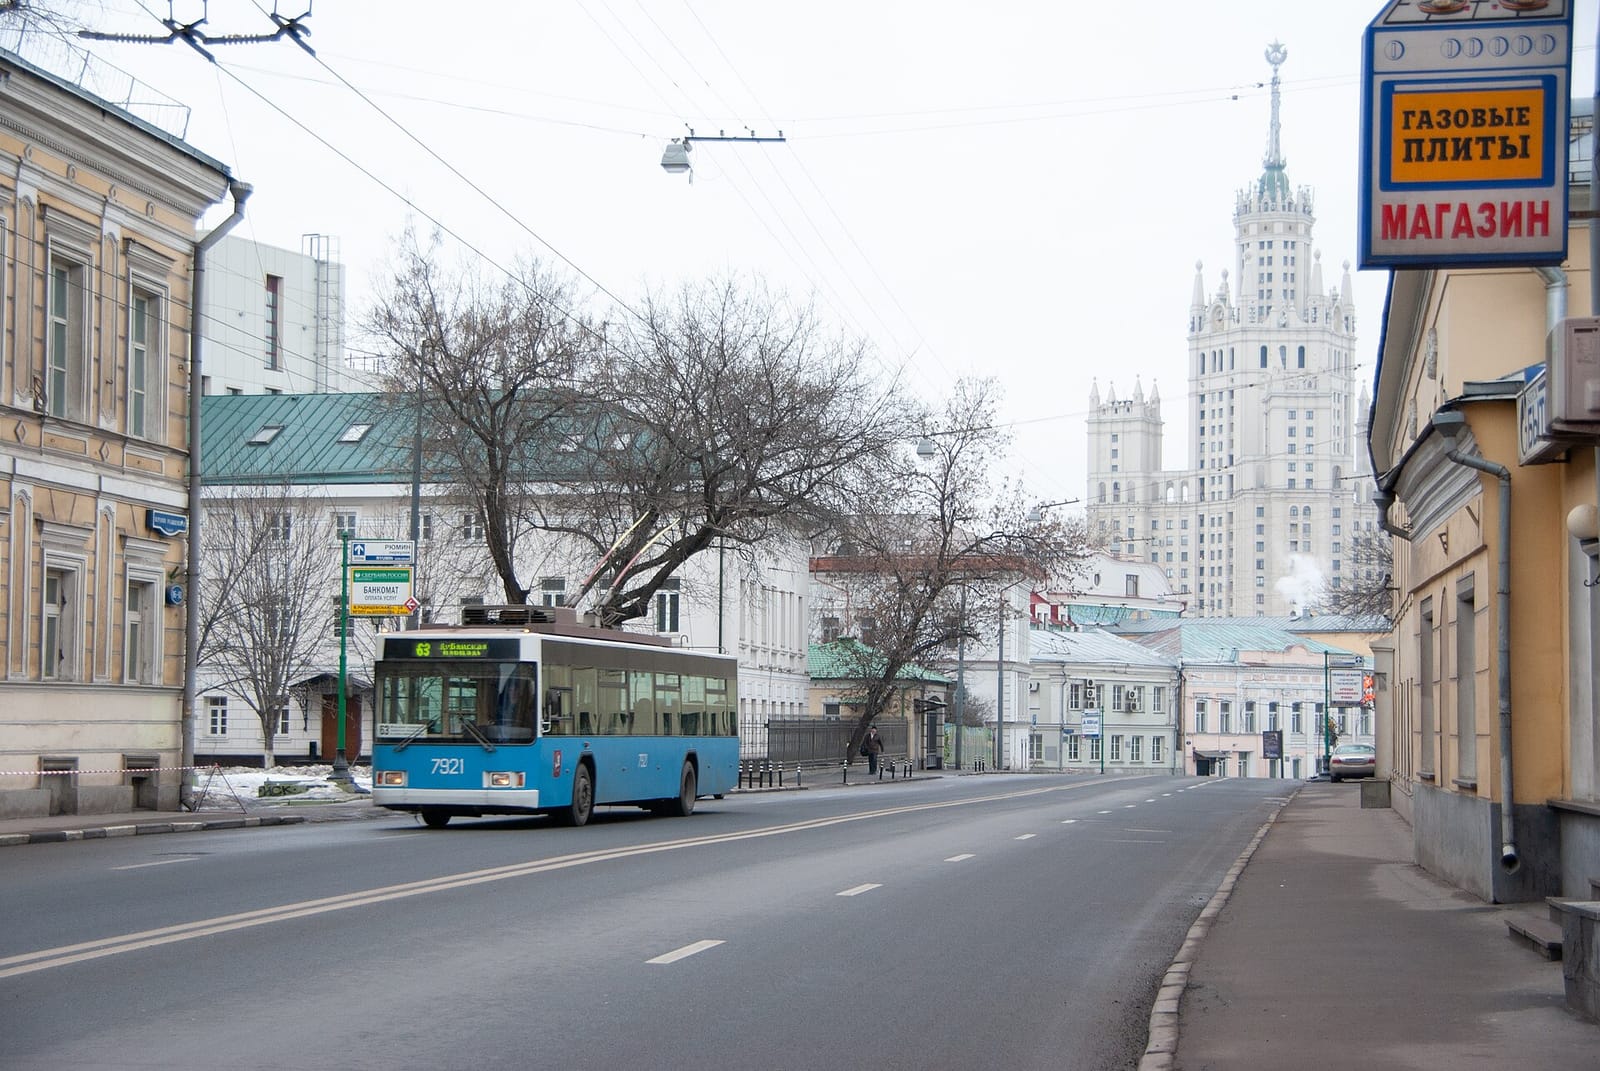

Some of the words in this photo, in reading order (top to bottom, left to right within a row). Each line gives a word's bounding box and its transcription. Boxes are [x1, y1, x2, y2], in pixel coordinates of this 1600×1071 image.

[1401, 106, 1531, 131] ГАЗОВЫЕ
[1402, 135, 1531, 163] ПЛИТЫ
[1381, 200, 1550, 241] МАГАЗИН
[363, 586, 399, 594] БАНКОМАТ
[416, 643, 431, 657] 63
[379, 724, 390, 736] 63
[431, 758, 464, 775] 7921
